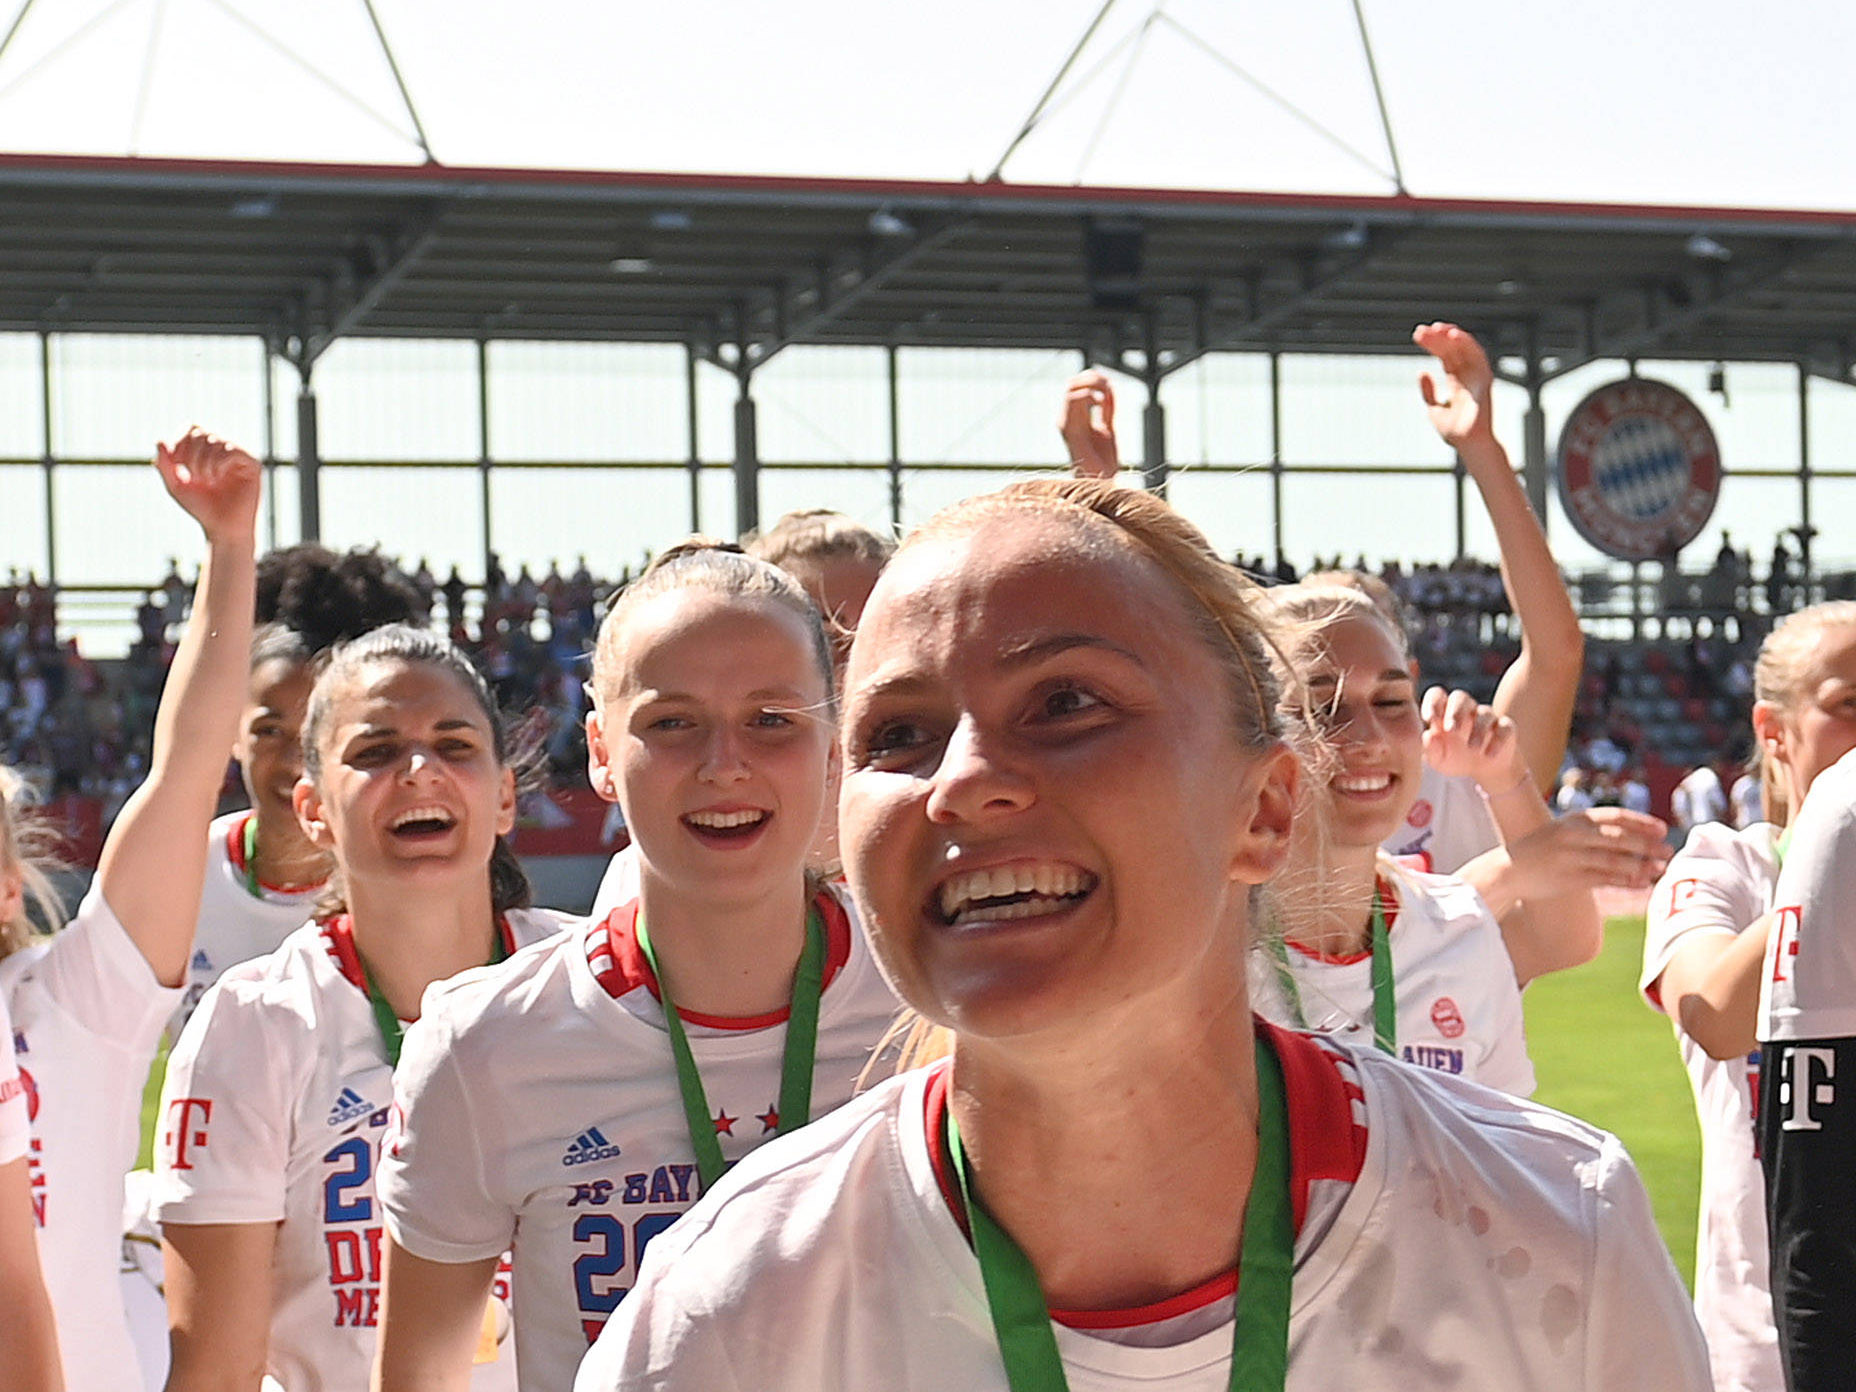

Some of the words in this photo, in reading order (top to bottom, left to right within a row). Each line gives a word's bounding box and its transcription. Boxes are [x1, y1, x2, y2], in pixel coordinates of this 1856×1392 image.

[1402, 1046, 1465, 1076] AUEN
[1780, 1047, 1835, 1131] T
[327, 1101, 375, 1127] adidas
[165, 1099, 212, 1170] T
[562, 1144, 621, 1167] adidas
